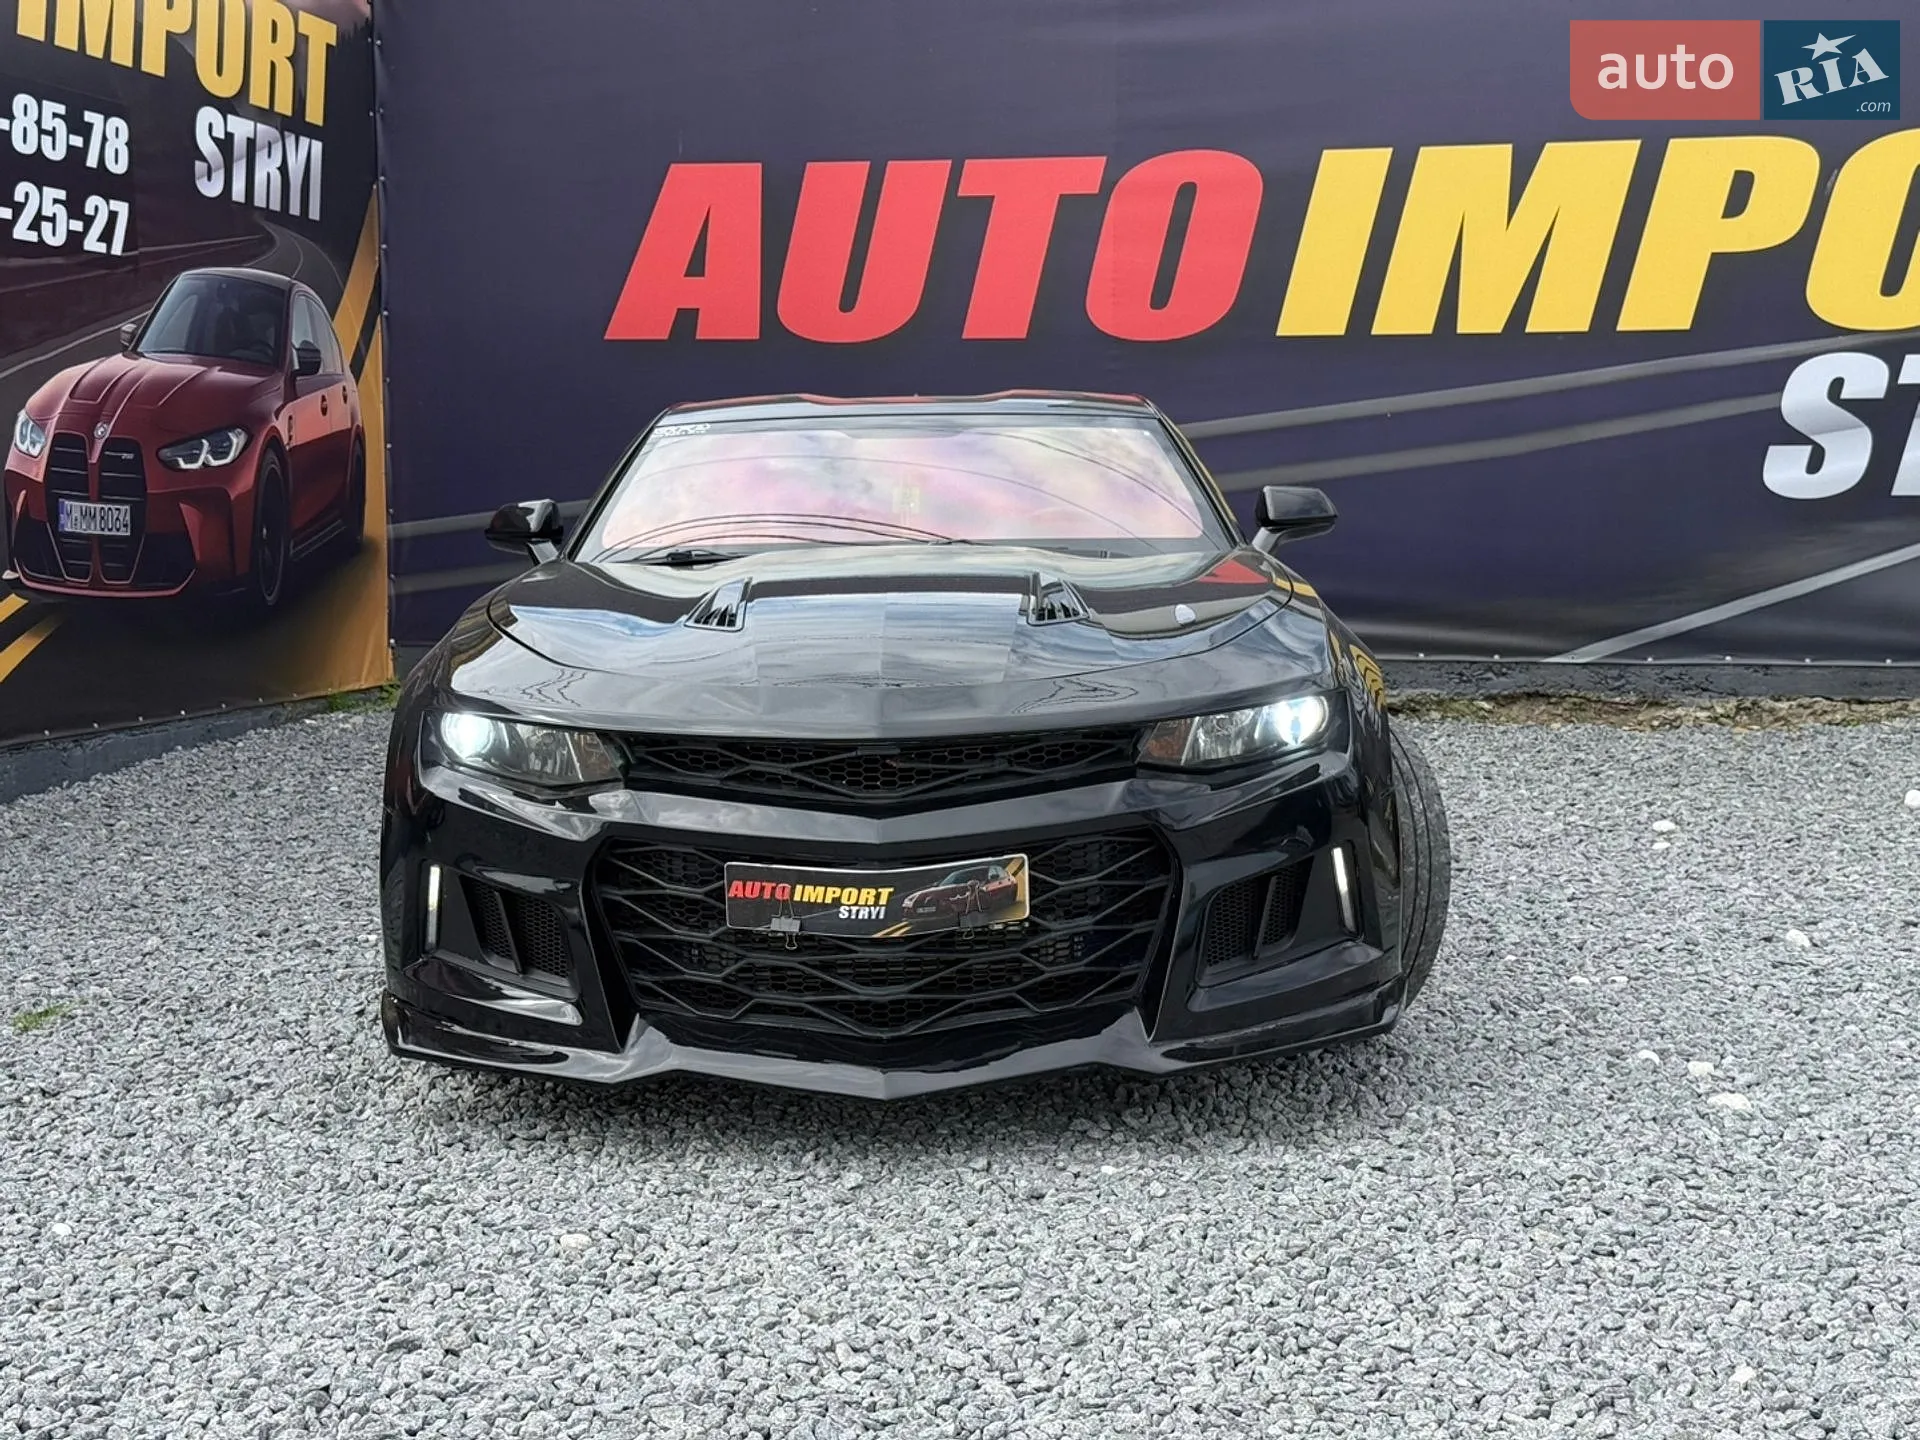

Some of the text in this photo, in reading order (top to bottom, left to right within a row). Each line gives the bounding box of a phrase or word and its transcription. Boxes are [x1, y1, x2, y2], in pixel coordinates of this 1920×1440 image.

[16, 0, 337, 127] PORT
[194, 106, 323, 221] STRYI
[604, 149, 1263, 343] AUTO
[1763, 352, 1920, 499] S
[728, 880, 894, 905] AUTO IMPORT
[838, 905, 885, 920] STRYI
